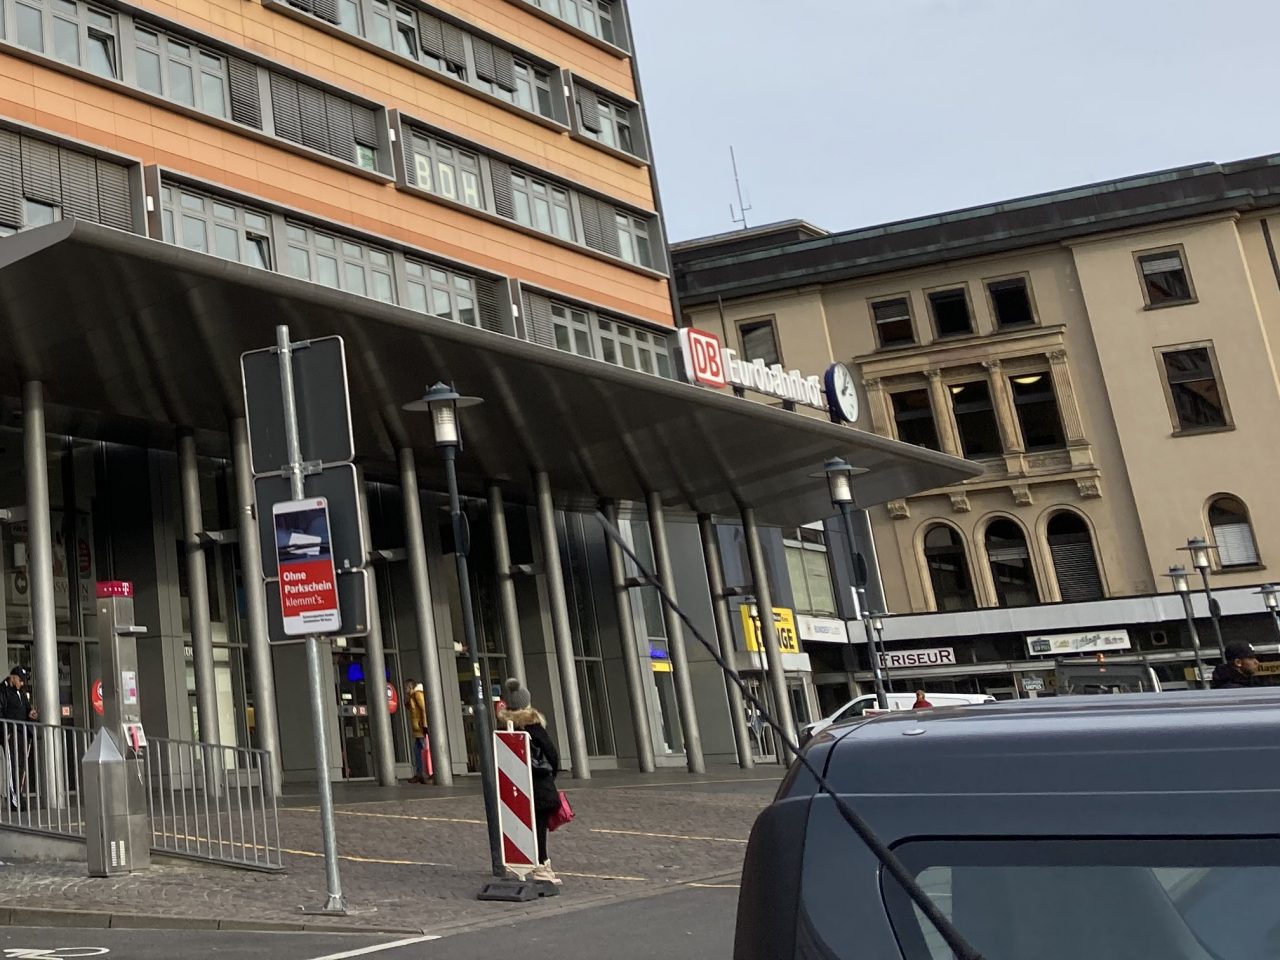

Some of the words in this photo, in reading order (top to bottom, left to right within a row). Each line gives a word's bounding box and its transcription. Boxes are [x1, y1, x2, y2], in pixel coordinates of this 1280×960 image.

[693, 337, 721, 378] DB
[721, 348, 824, 408] Eurobahnhof
[283, 571, 307, 582] Ohne
[284, 581, 332, 594] Parkschein
[878, 649, 952, 667] FRISEUR
